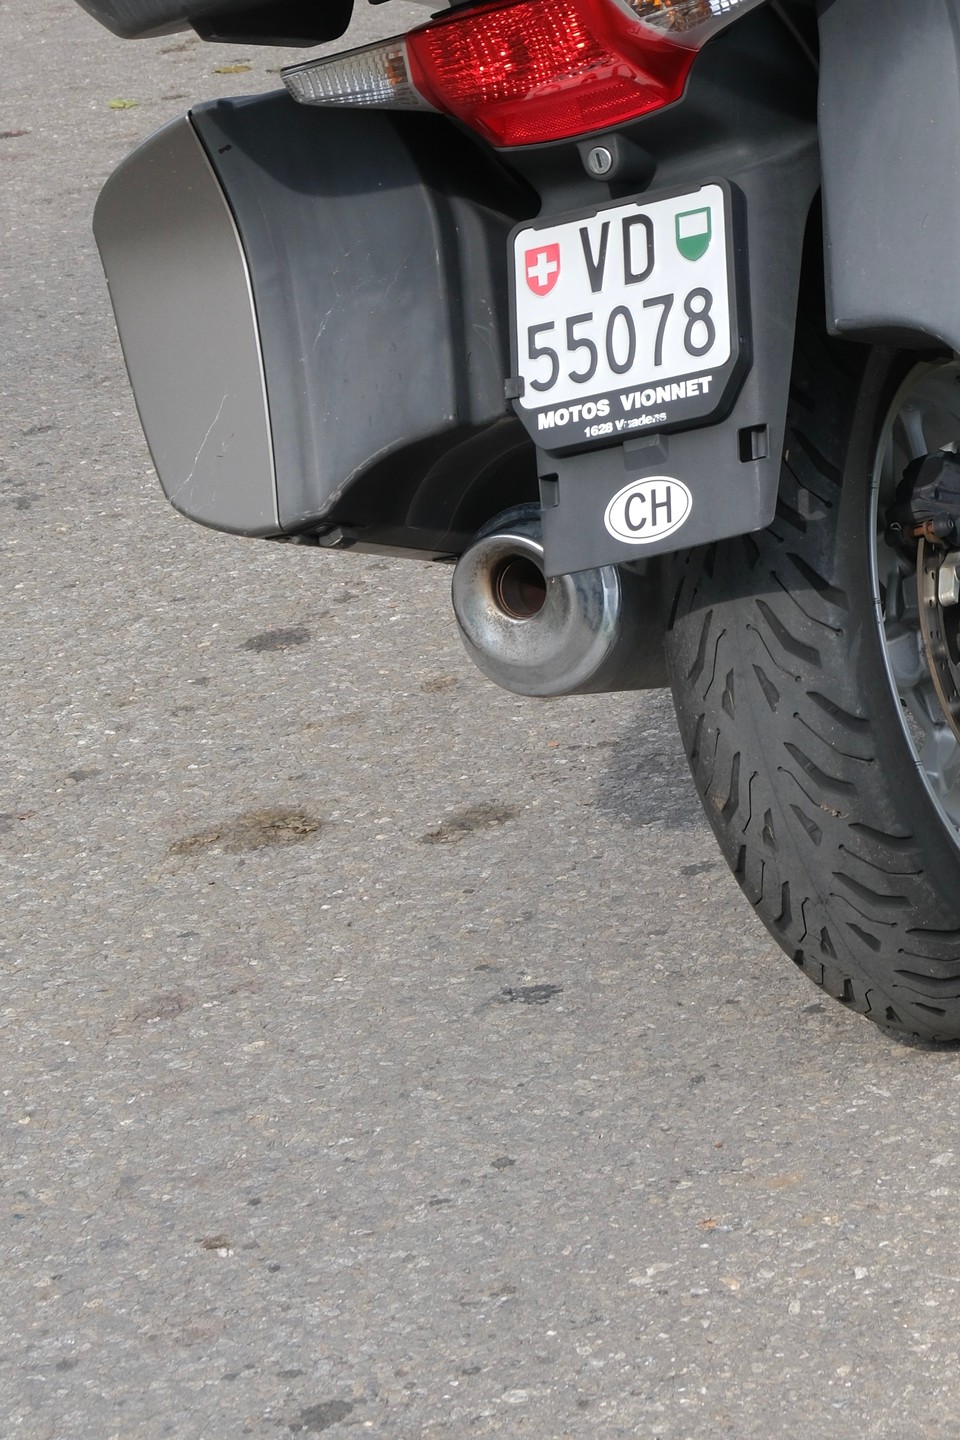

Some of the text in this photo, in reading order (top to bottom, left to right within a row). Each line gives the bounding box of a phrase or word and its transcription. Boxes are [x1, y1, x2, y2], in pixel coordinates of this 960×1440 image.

[579, 213, 655, 293] VD
[527, 287, 716, 392] 55078
[537, 375, 712, 430] MOTOS VIONNET
[584, 421, 614, 438] 1628
[624, 485, 673, 532] CH
